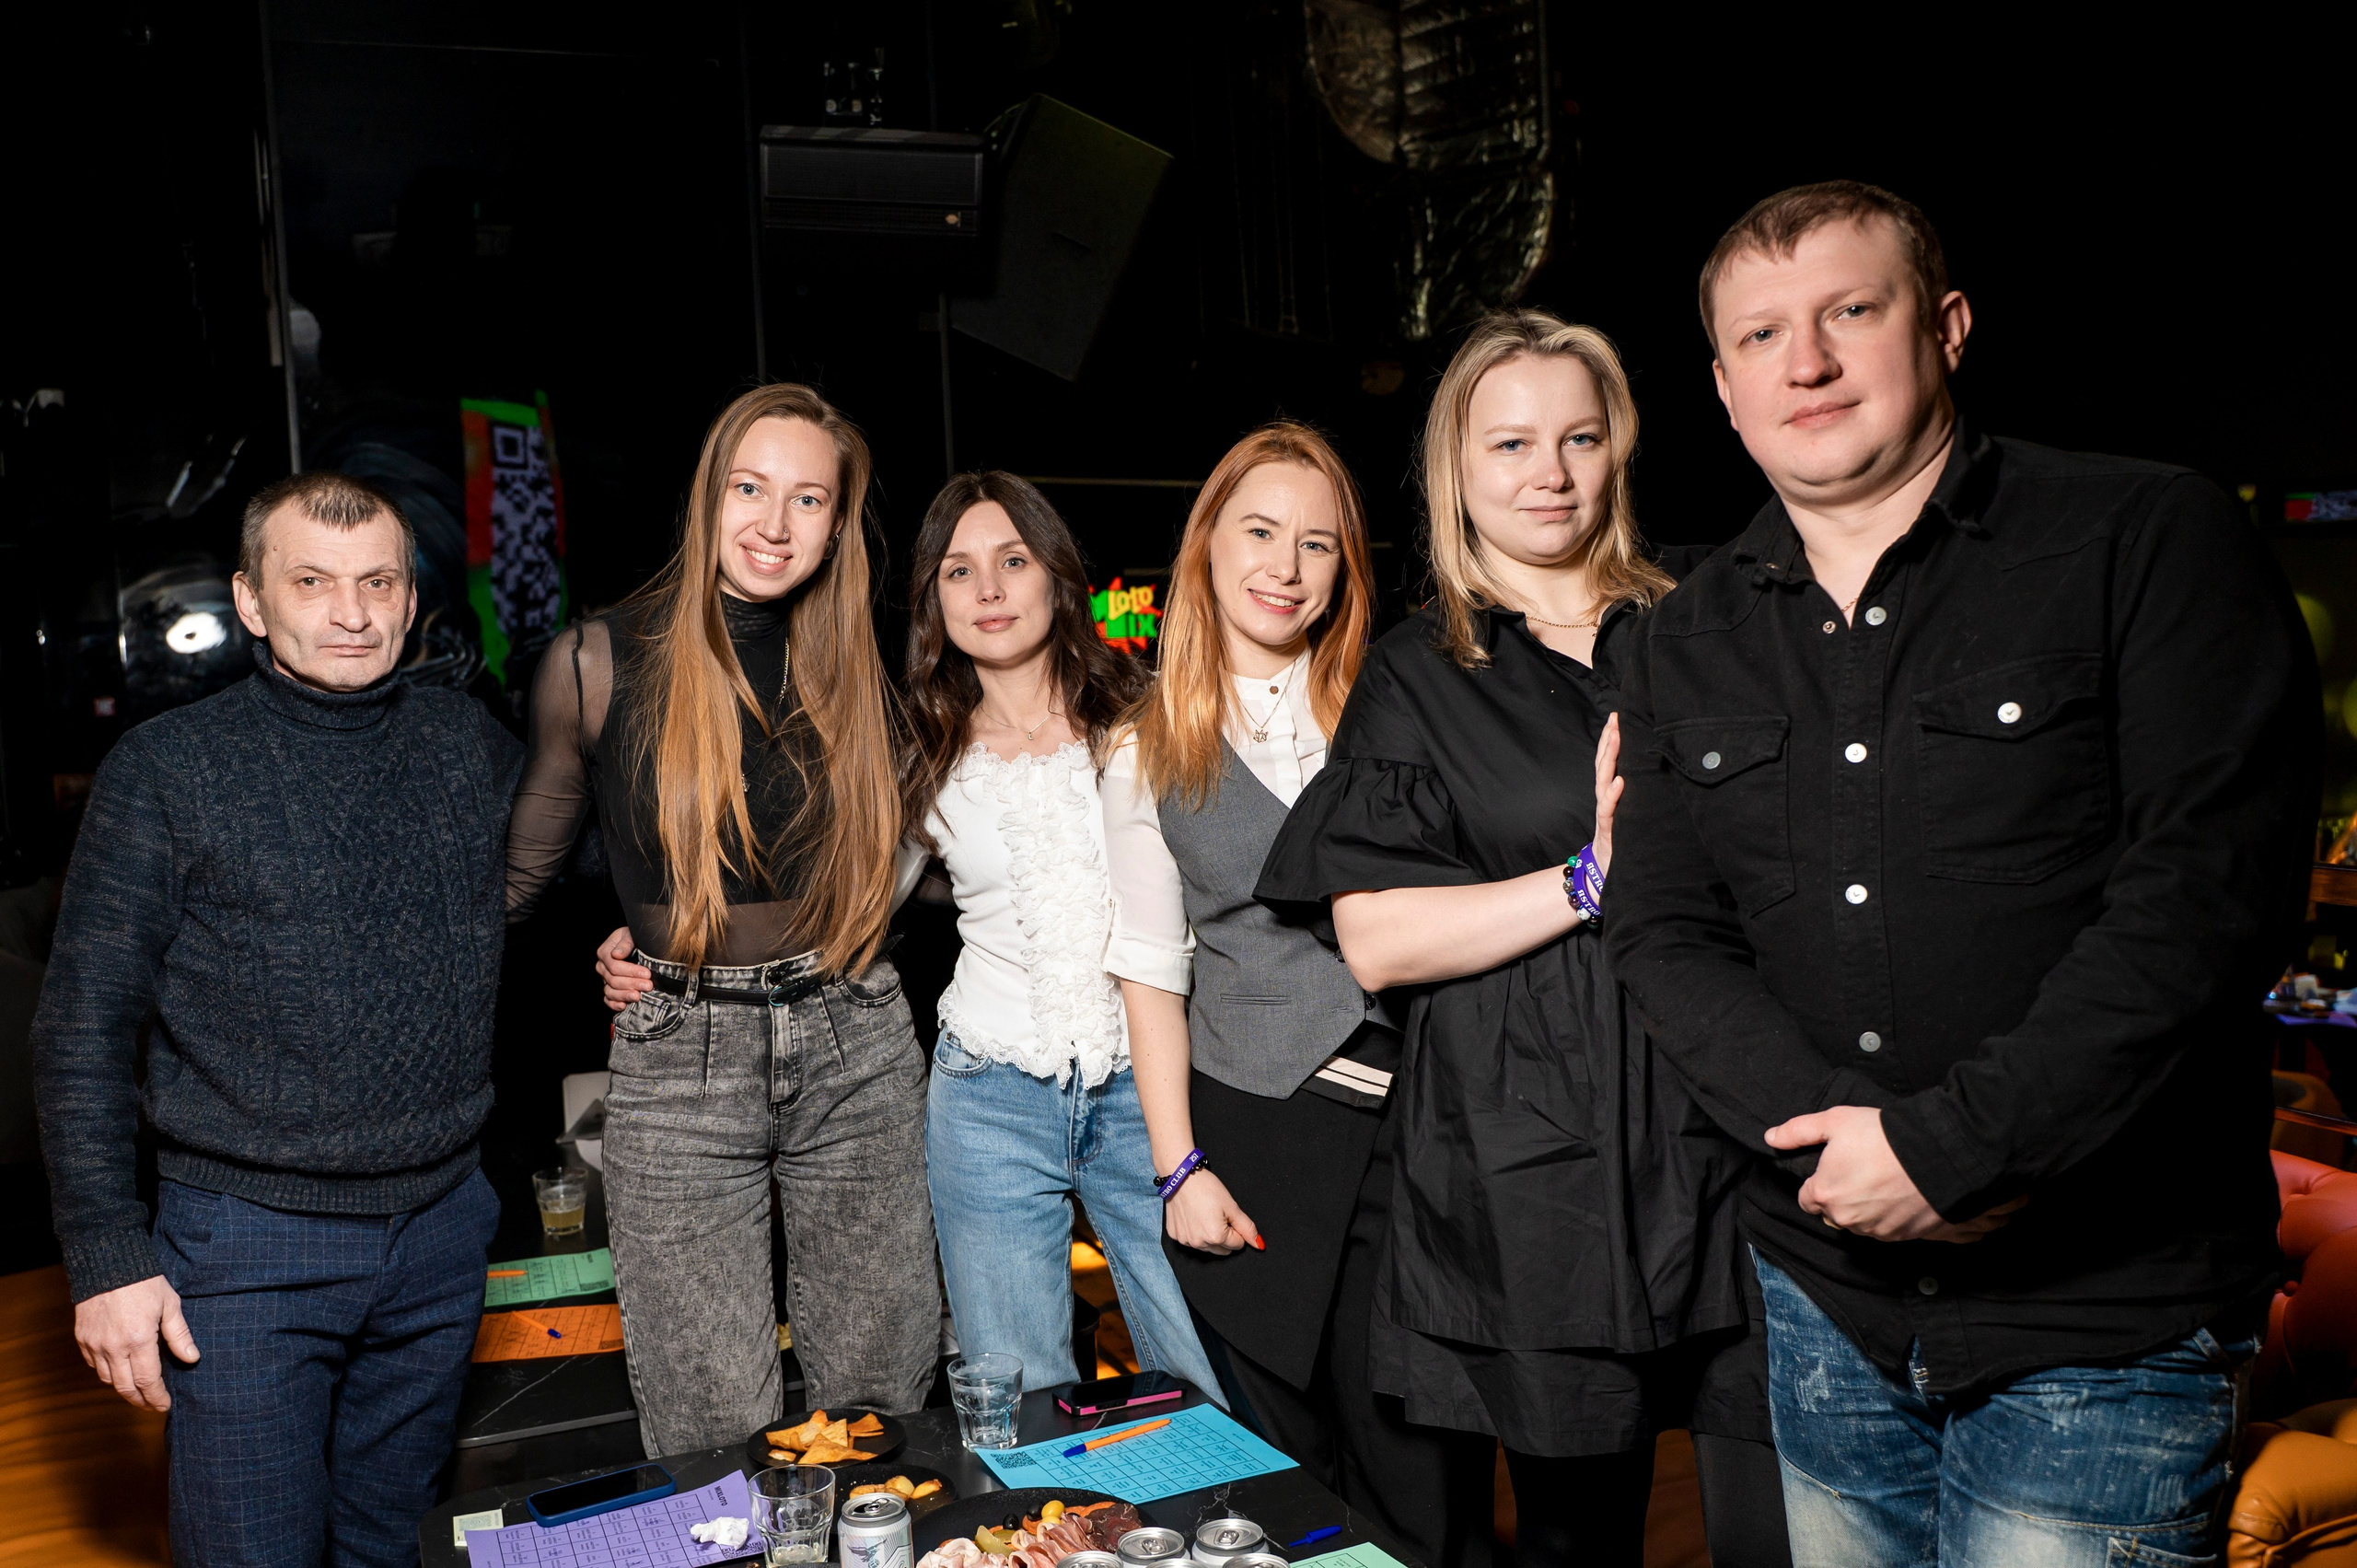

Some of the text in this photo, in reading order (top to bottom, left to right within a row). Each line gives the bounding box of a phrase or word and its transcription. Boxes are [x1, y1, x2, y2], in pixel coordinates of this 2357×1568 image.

[1170, 1167, 1186, 1186] CLUB
[1189, 1153, 1199, 1162] 257
[714, 1485, 727, 1506] MIXLOTO
